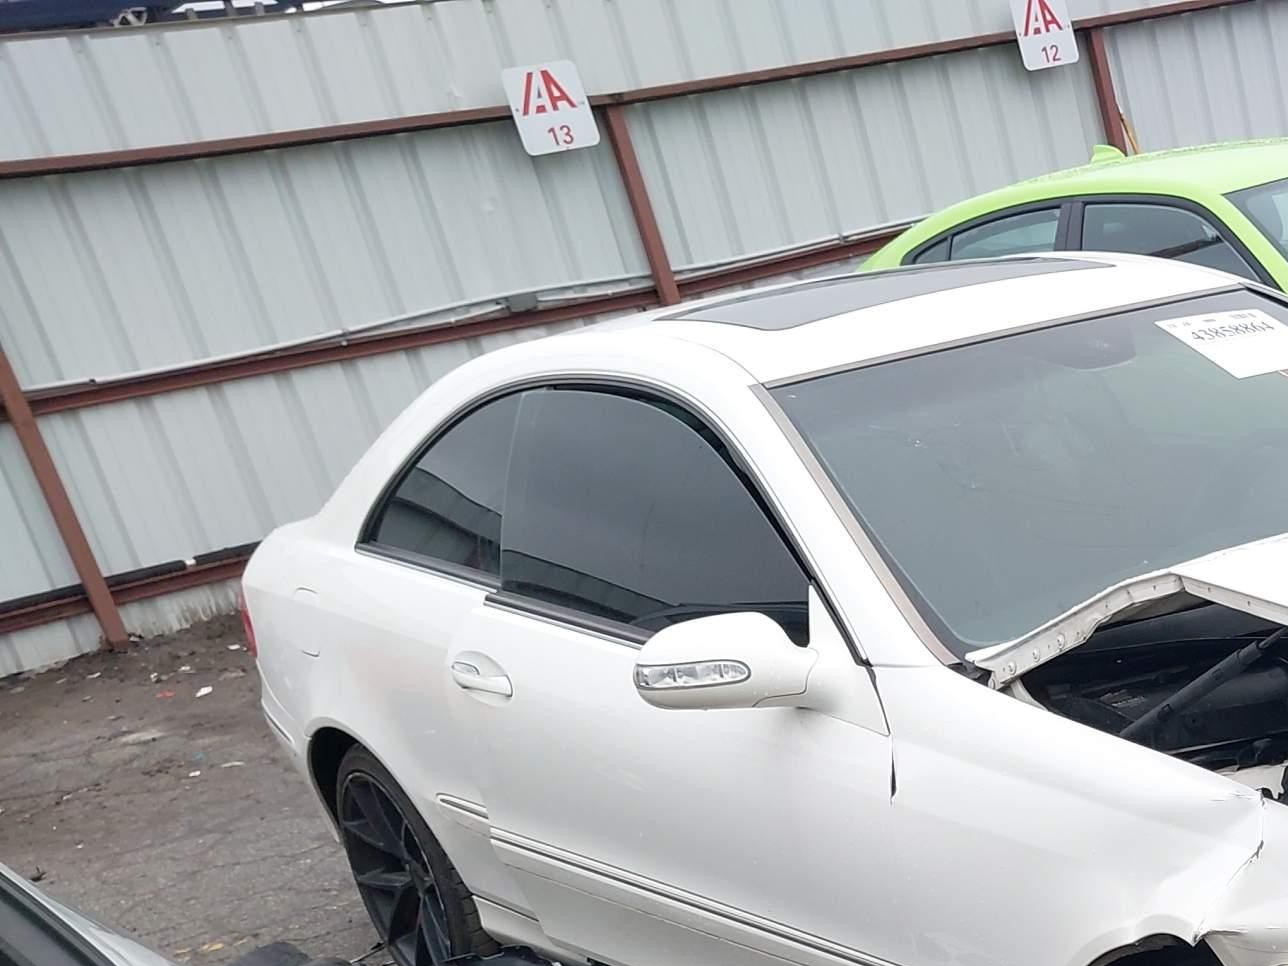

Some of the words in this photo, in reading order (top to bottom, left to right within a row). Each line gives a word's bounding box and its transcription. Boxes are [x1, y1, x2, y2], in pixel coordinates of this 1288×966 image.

[1041, 44, 1062, 64] 12
[547, 124, 575, 147] 13
[1191, 319, 1275, 342] 43858864
